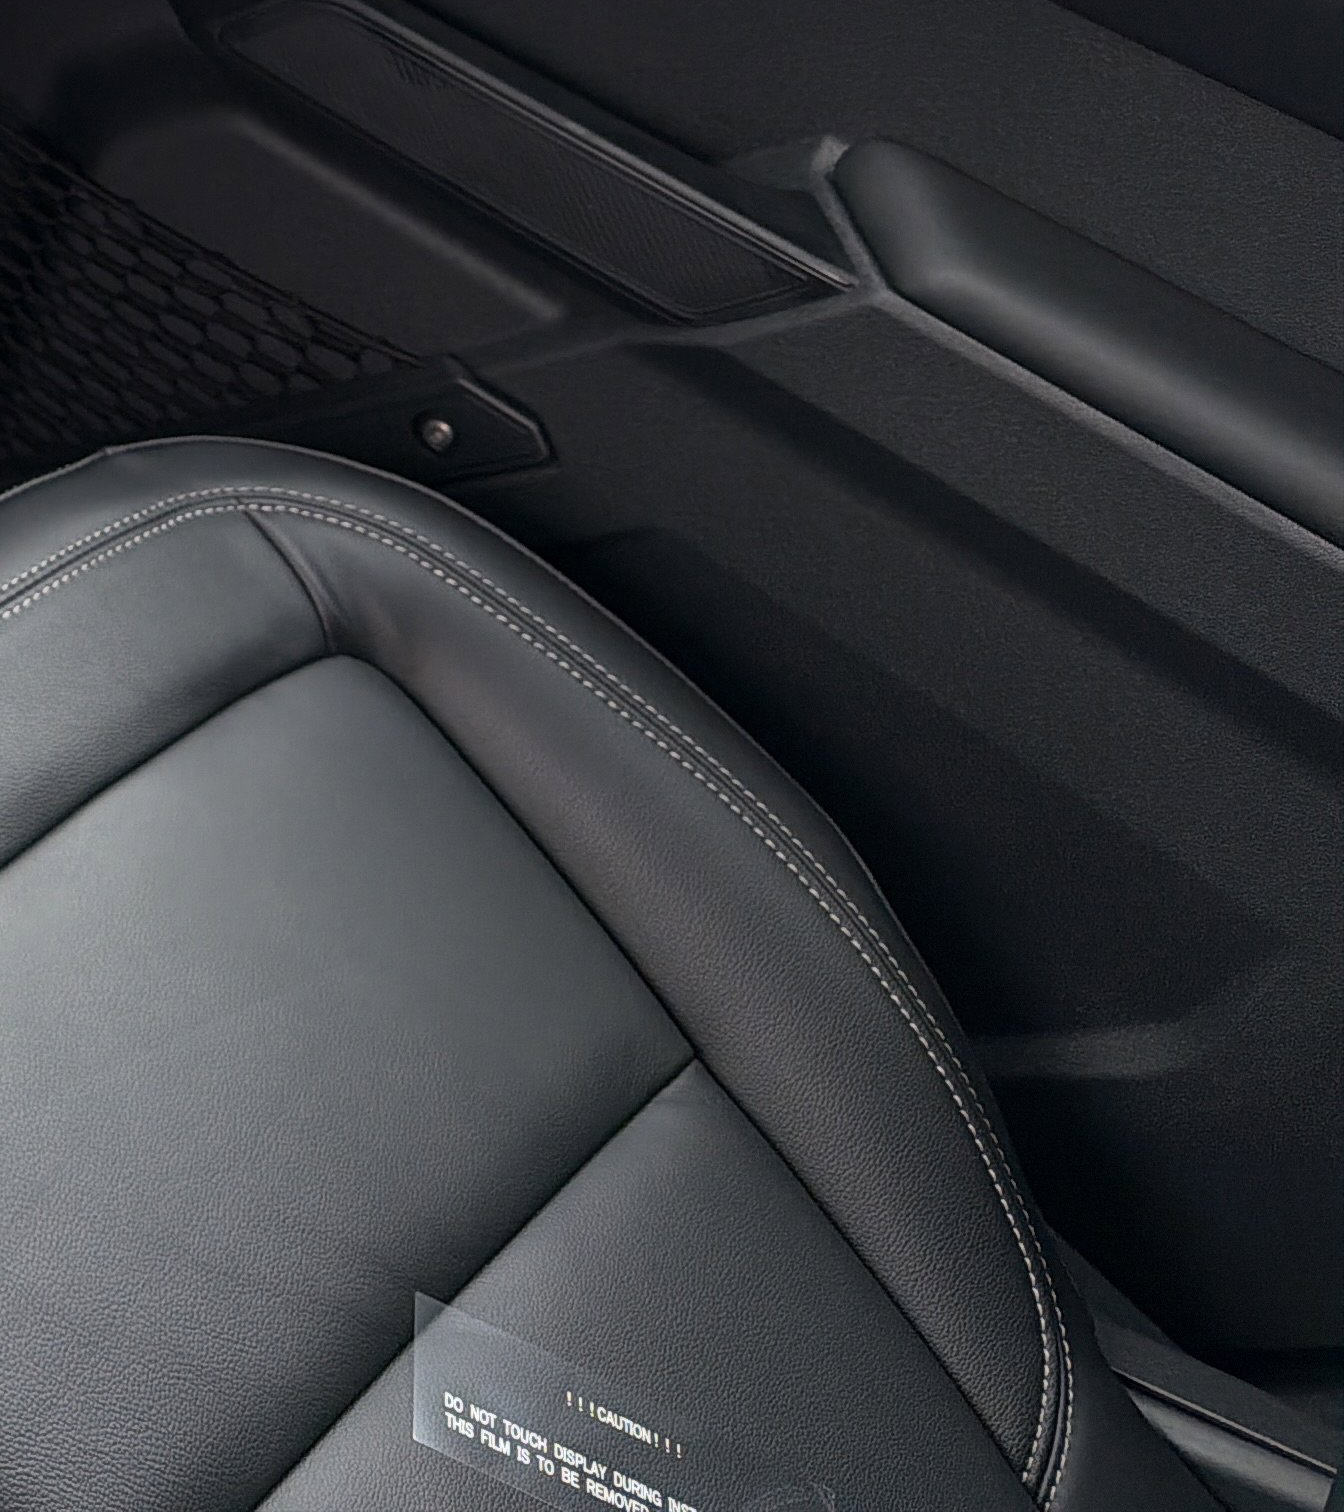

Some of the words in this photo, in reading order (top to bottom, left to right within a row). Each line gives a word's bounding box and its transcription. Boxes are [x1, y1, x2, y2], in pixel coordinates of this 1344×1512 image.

[444, 1390, 464, 1414] DO
[469, 1403, 498, 1429] NOT
[502, 1418, 549, 1454] TOUCH
[553, 1442, 608, 1482] DISPLAY
[612, 1470, 663, 1508] DURING
[444, 1411, 475, 1439] THIS
[480, 1428, 511, 1457] FILM
[516, 1444, 531, 1466] IS
[536, 1454, 555, 1477] TO
[561, 1465, 581, 1489] BE
